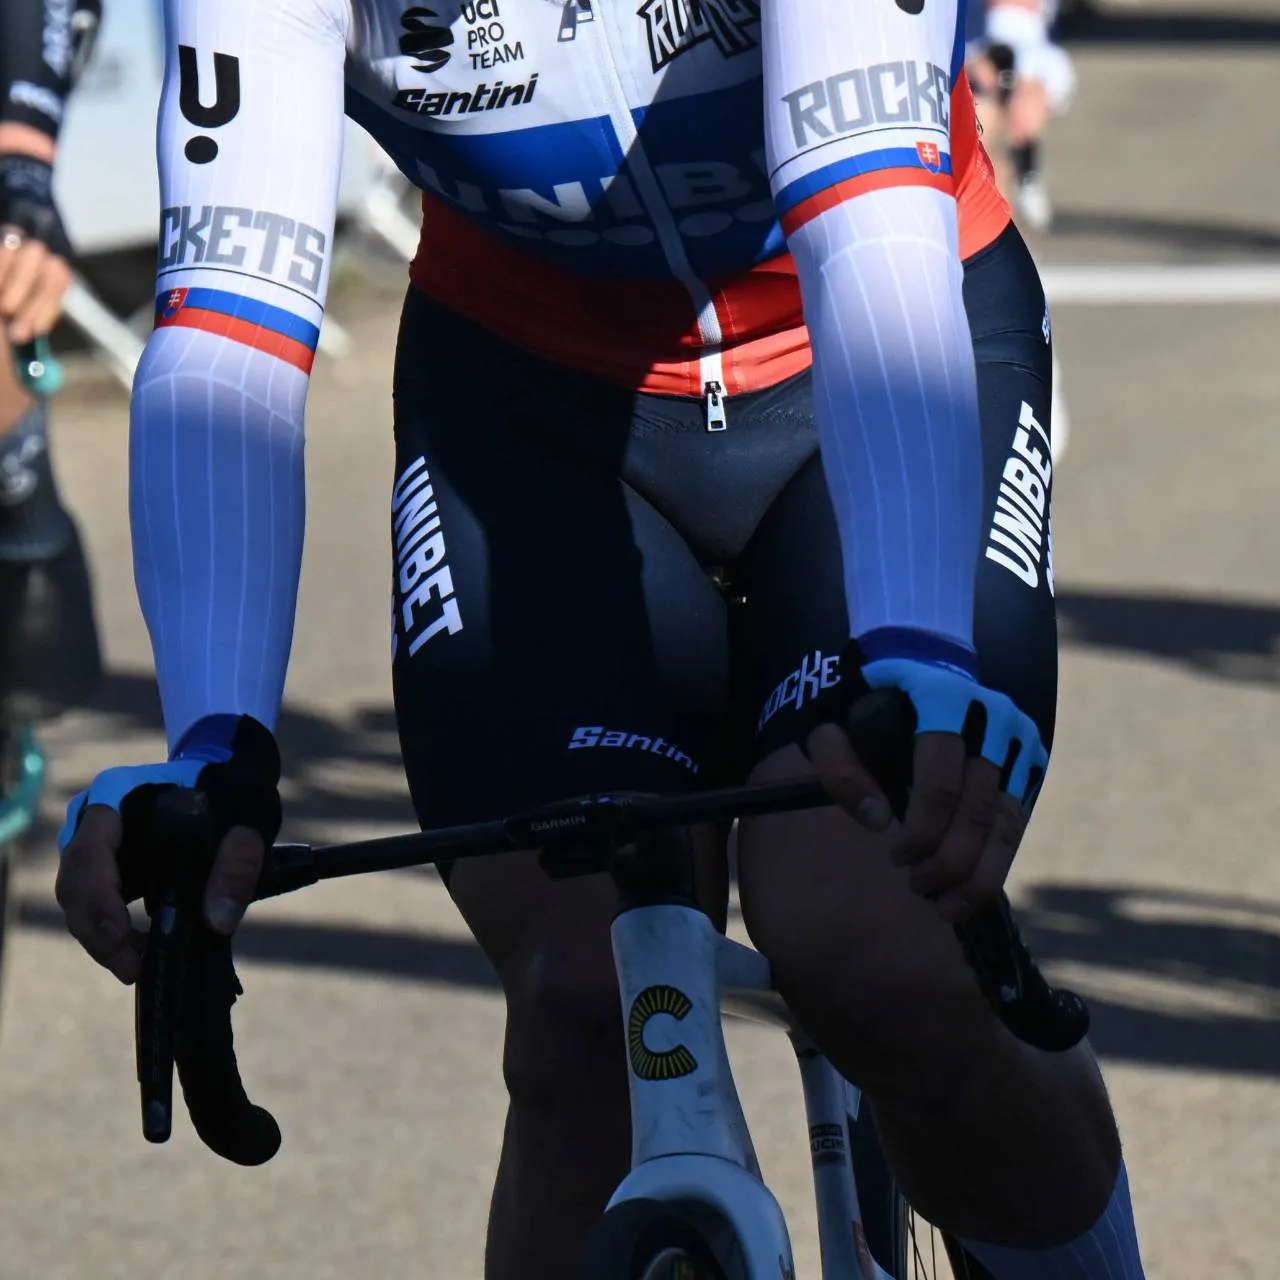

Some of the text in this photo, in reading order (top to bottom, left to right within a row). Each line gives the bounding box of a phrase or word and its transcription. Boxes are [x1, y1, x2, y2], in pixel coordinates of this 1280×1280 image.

[467, 22, 504, 50] PRO
[469, 41, 524, 70] TEAM
[391, 72, 539, 117] Santini
[415, 147, 773, 226] UNIB
[985, 399, 1052, 589] UNIBET
[391, 455, 464, 658] UNIBET
[530, 813, 587, 832] GARMIN
